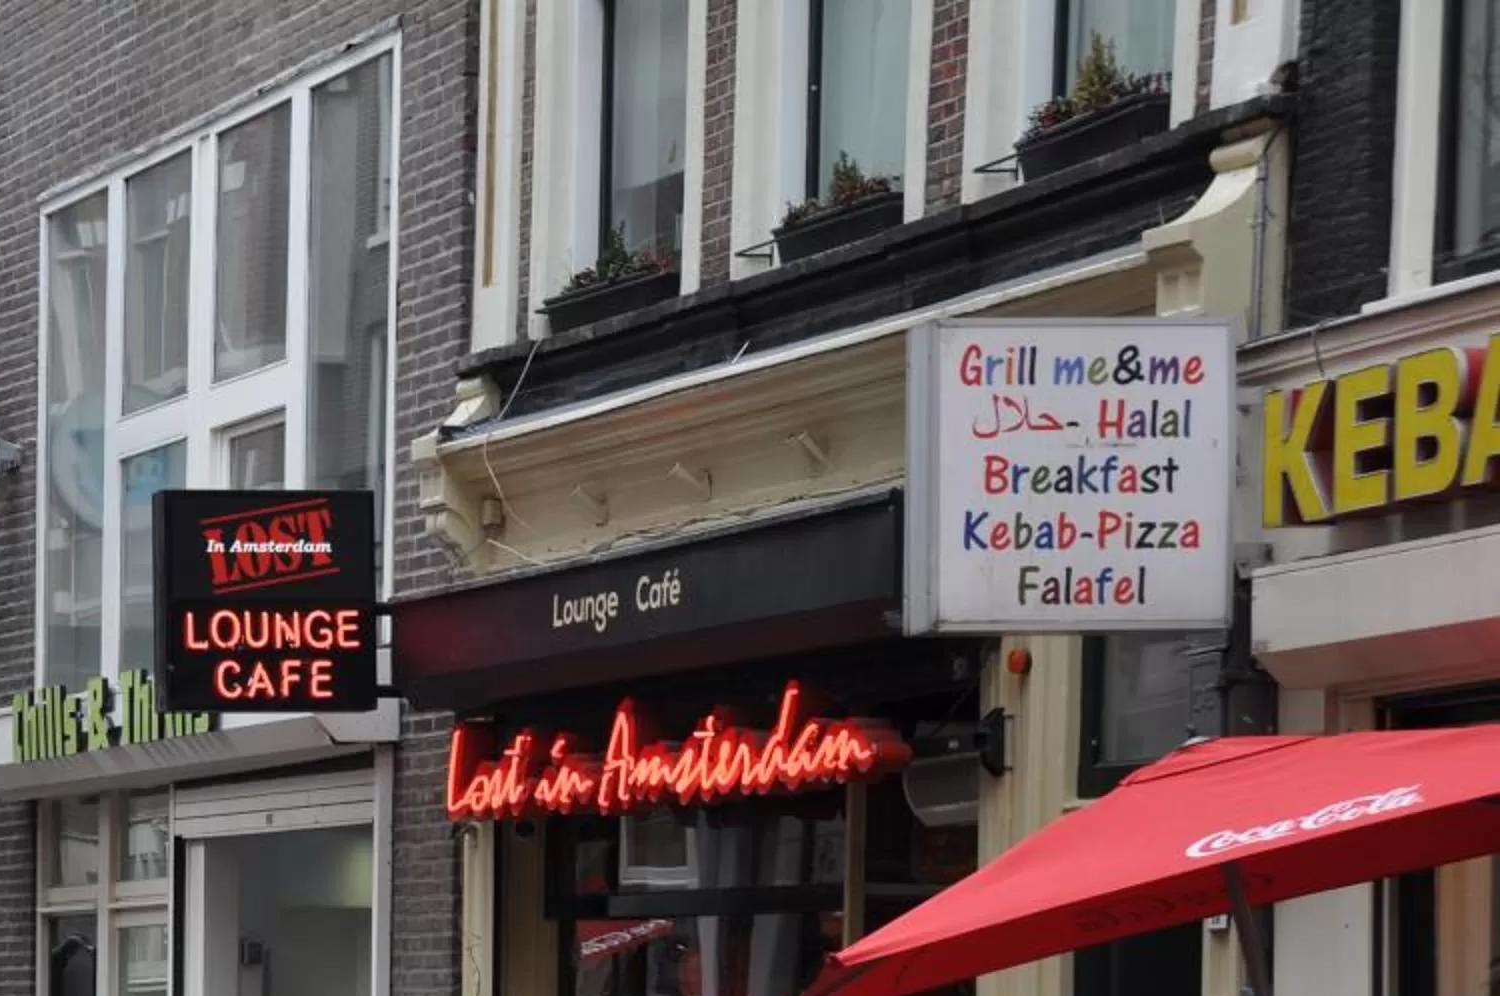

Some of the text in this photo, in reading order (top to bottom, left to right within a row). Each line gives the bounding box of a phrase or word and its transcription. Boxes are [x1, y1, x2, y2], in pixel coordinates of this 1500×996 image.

[959, 344, 1037, 386] Grill
[1097, 399, 1192, 438] Halal
[984, 455, 1180, 494] Breakfast
[202, 509, 333, 585] LOST
[207, 539, 332, 554] In Amsterdam
[963, 510, 1201, 551] Kebab-Pizza
[553, 568, 682, 632] Lounge Café
[1017, 566, 1146, 606] Falafel
[184, 609, 361, 650] LOUNGE
[214, 659, 334, 699] CAFE
[11, 684, 77, 764] Chills
[88, 675, 109, 752] &
[447, 726, 533, 814] Lost
[598, 690, 874, 810] Amsterdam
